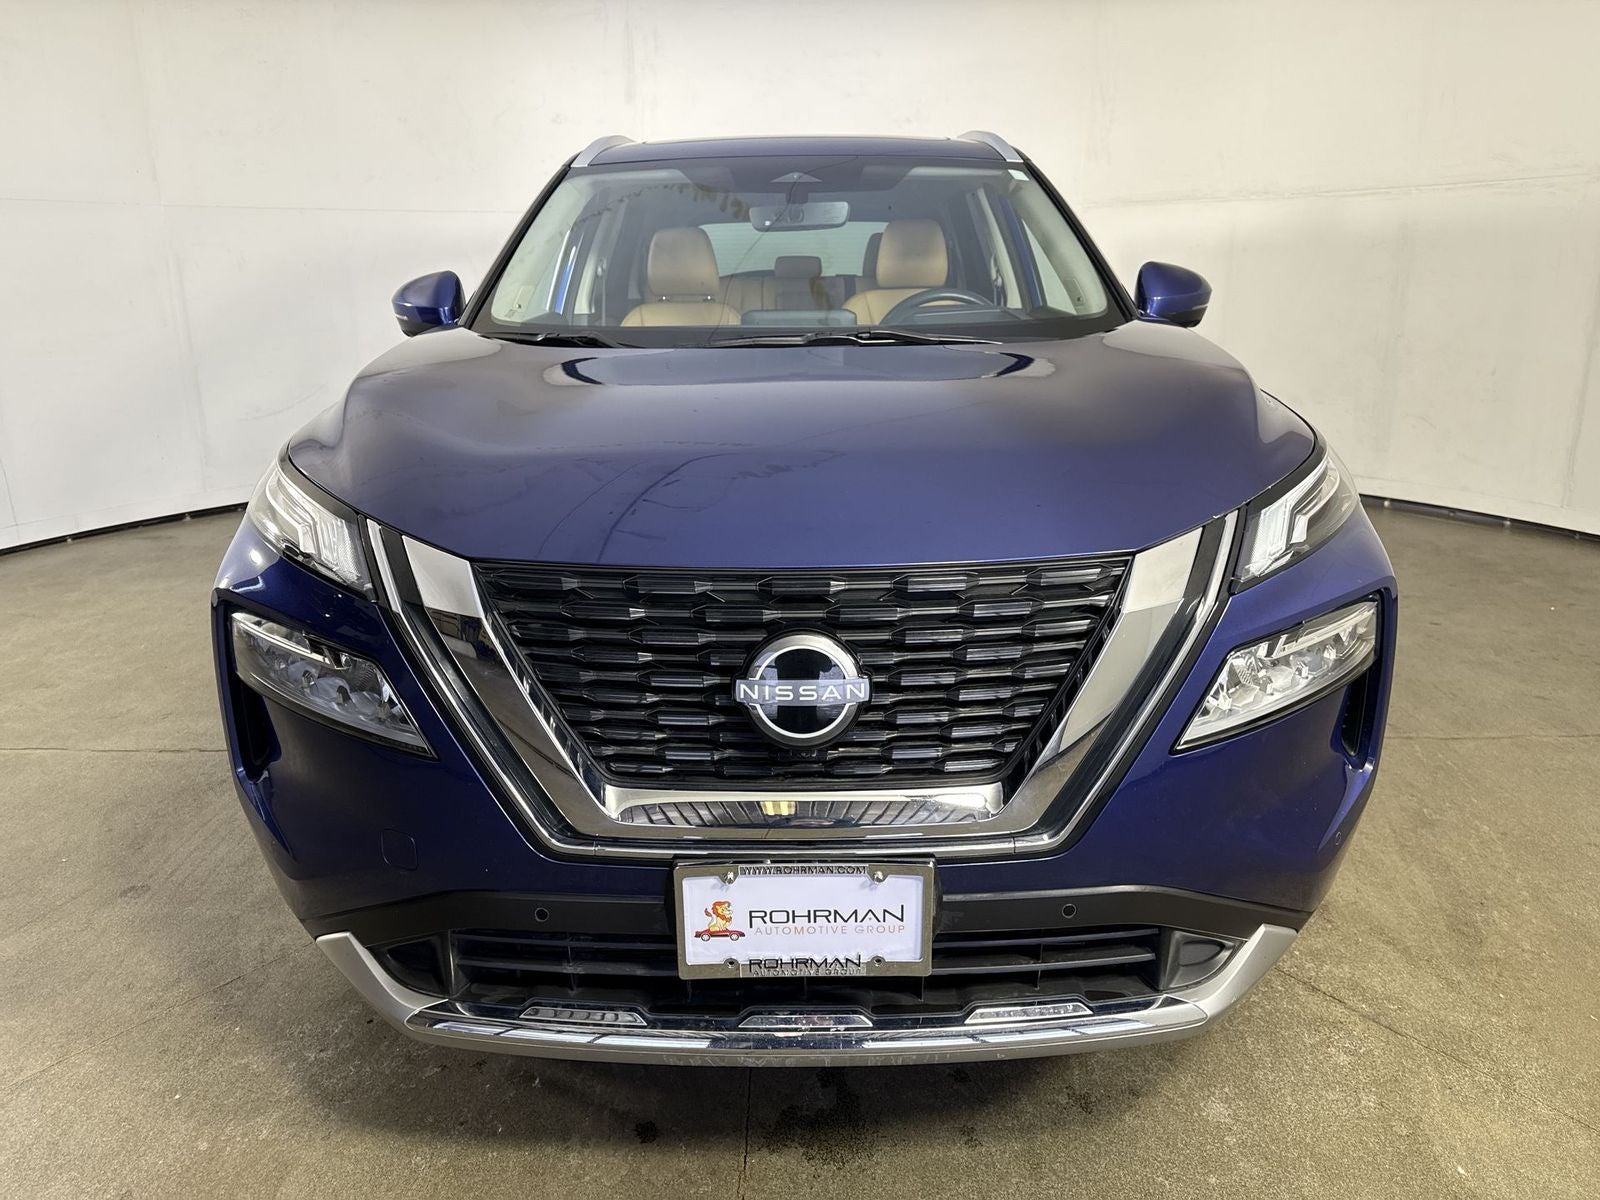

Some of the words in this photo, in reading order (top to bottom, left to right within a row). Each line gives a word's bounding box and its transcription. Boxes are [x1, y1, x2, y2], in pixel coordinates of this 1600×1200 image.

[740, 684, 865, 701] NISSAN
[741, 866, 866, 875] WWW.ROHRMAN.COM
[749, 905, 904, 929] ROHRMAN
[754, 926, 848, 935] AUTOMOTIVE
[855, 924, 905, 935] GROUP
[749, 955, 861, 973] ROHRMAN
[753, 968, 820, 976] AUTOMOTIVE
[825, 968, 861, 976] GROUP
